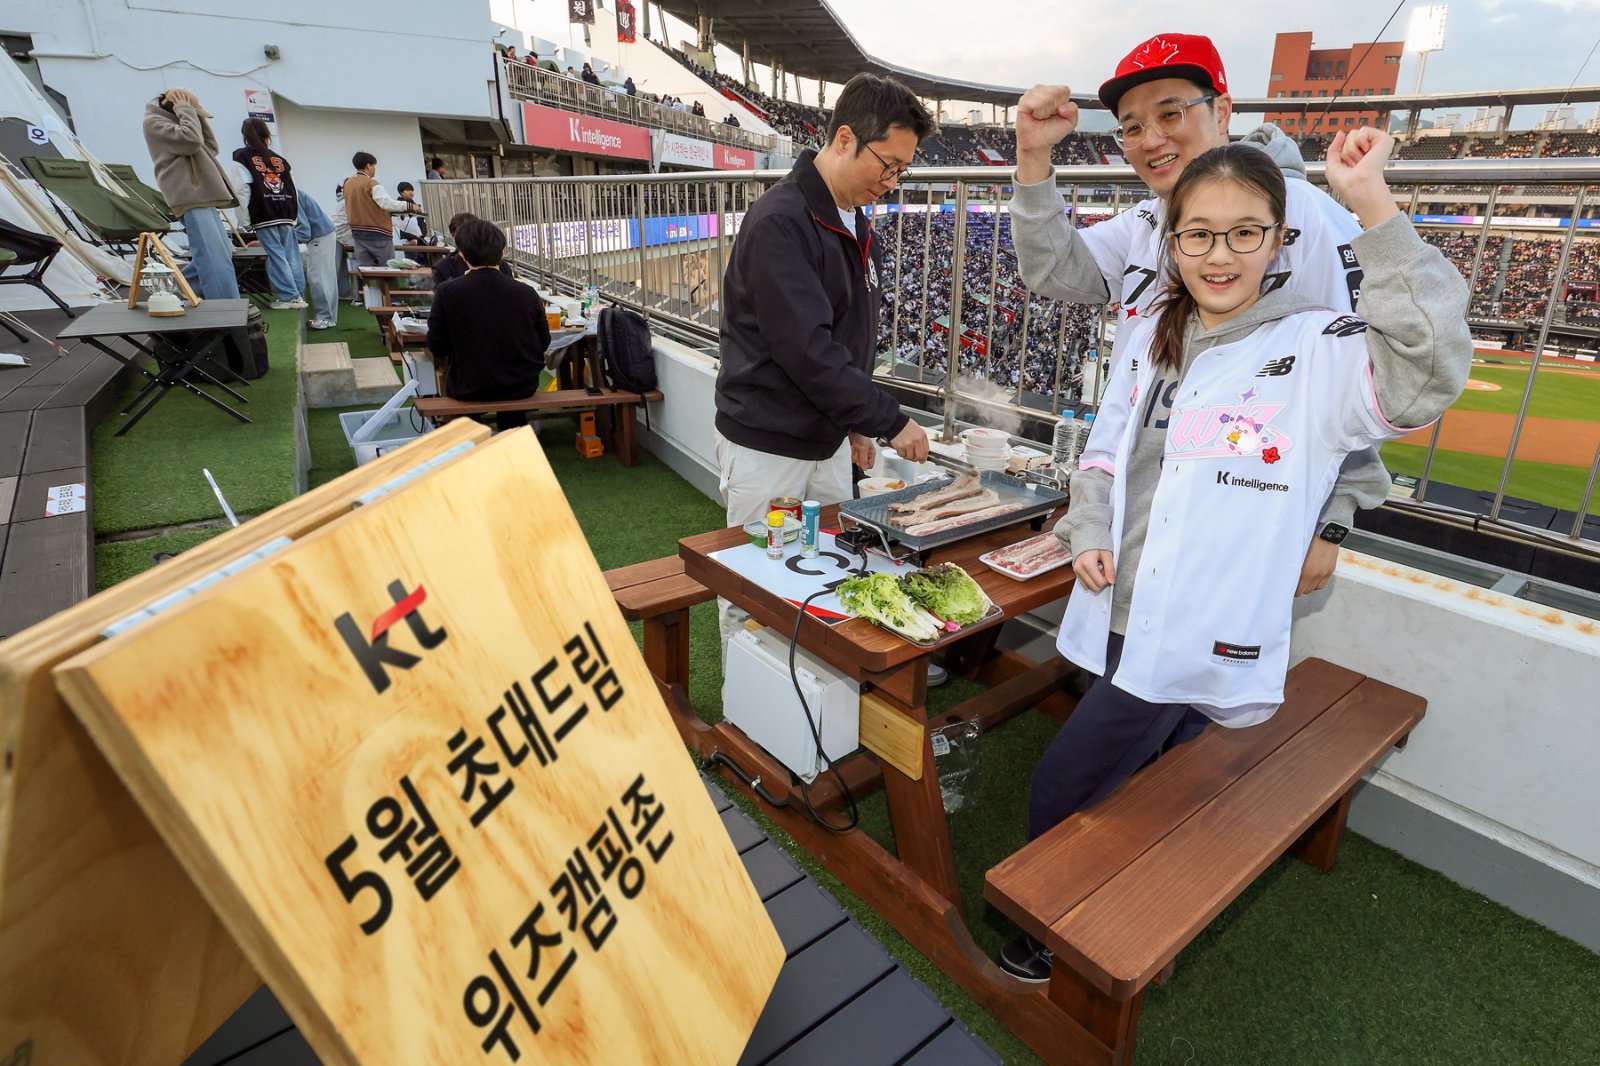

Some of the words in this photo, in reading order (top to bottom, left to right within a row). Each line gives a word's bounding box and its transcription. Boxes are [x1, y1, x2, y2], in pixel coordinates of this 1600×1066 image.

[569, 118, 581, 142] K
[581, 126, 622, 150] intelligence
[1216, 471, 1230, 485] K
[1231, 476, 1289, 492] intelligence
[334, 578, 448, 695] kt
[324, 775, 461, 937] 5월
[446, 621, 625, 829] 초대드림
[463, 773, 675, 1065] 위즈캠핑존
